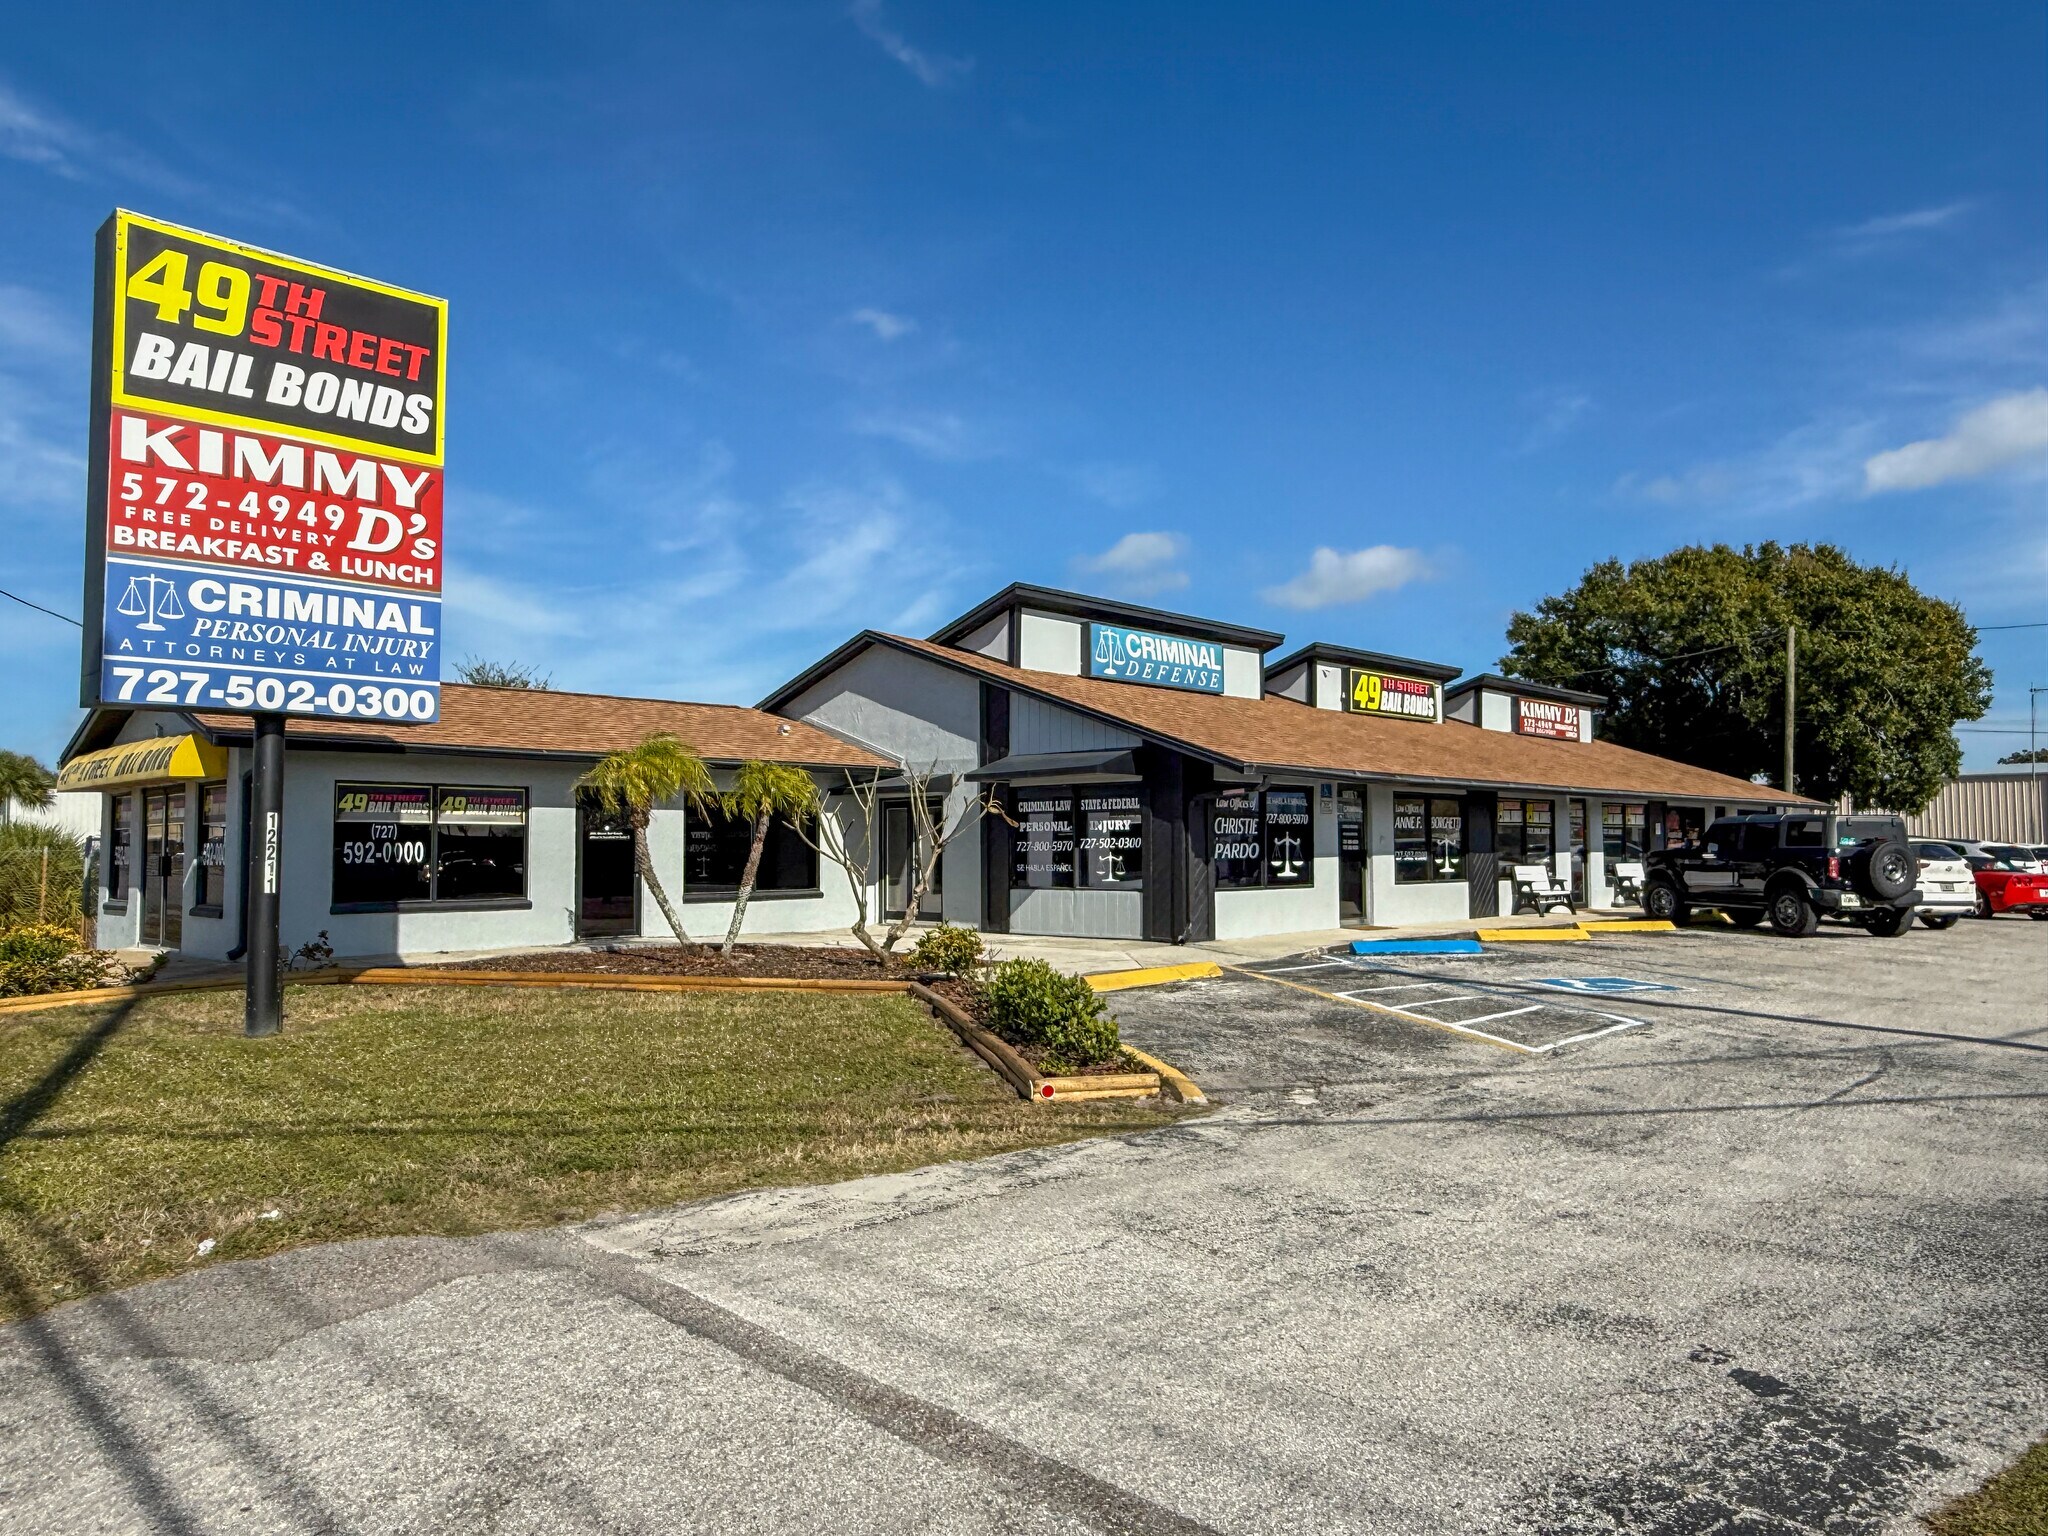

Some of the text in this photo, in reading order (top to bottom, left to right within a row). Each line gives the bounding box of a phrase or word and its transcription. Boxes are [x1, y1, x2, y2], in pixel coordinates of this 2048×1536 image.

[127, 249, 326, 336] 49 TH
[250, 307, 430, 381] STREET
[129, 332, 433, 435] BAIL BONDS
[121, 416, 430, 508] KIMMY
[120, 472, 345, 531] 572-4949
[125, 506, 336, 548] FREE DELIVERY
[347, 506, 436, 560] D's
[114, 525, 434, 585] BREAKFAST & LUNCH
[187, 579, 435, 636] CRIMINAL
[190, 617, 434, 659] PERSONAL INJURY
[1125, 633, 1222, 671] CRIMINAL
[120, 638, 424, 676] ATTORNEYS AT LAW
[1125, 660, 1220, 689] DEFENSE
[113, 666, 435, 720] 727-502-0300
[1354, 674, 1430, 710] 49 TH STREET
[1380, 691, 1435, 717] BAIL BONDS
[1520, 701, 1562, 722] KIMMY
[78, 755, 119, 782] STREET
[338, 793, 367, 813] 49
[367, 802, 430, 815] BAIL BONDS
[440, 797, 466, 816] 49
[1018, 800, 1072, 812] CRIMINAL LAW
[1081, 797, 1140, 810] STATE & FEDERAL
[371, 823, 398, 840] (727)
[1090, 820, 1131, 833] INJURY
[1214, 817, 1259, 834] CHRISTIE
[1394, 816, 1415, 829] ANNE
[265, 812, 277, 894] 12211
[343, 842, 424, 864] 592-0000
[1016, 841, 1074, 852] 727-800-5970
[1080, 837, 1142, 849] 727-502-0300
[1214, 842, 1260, 859] PARDO
